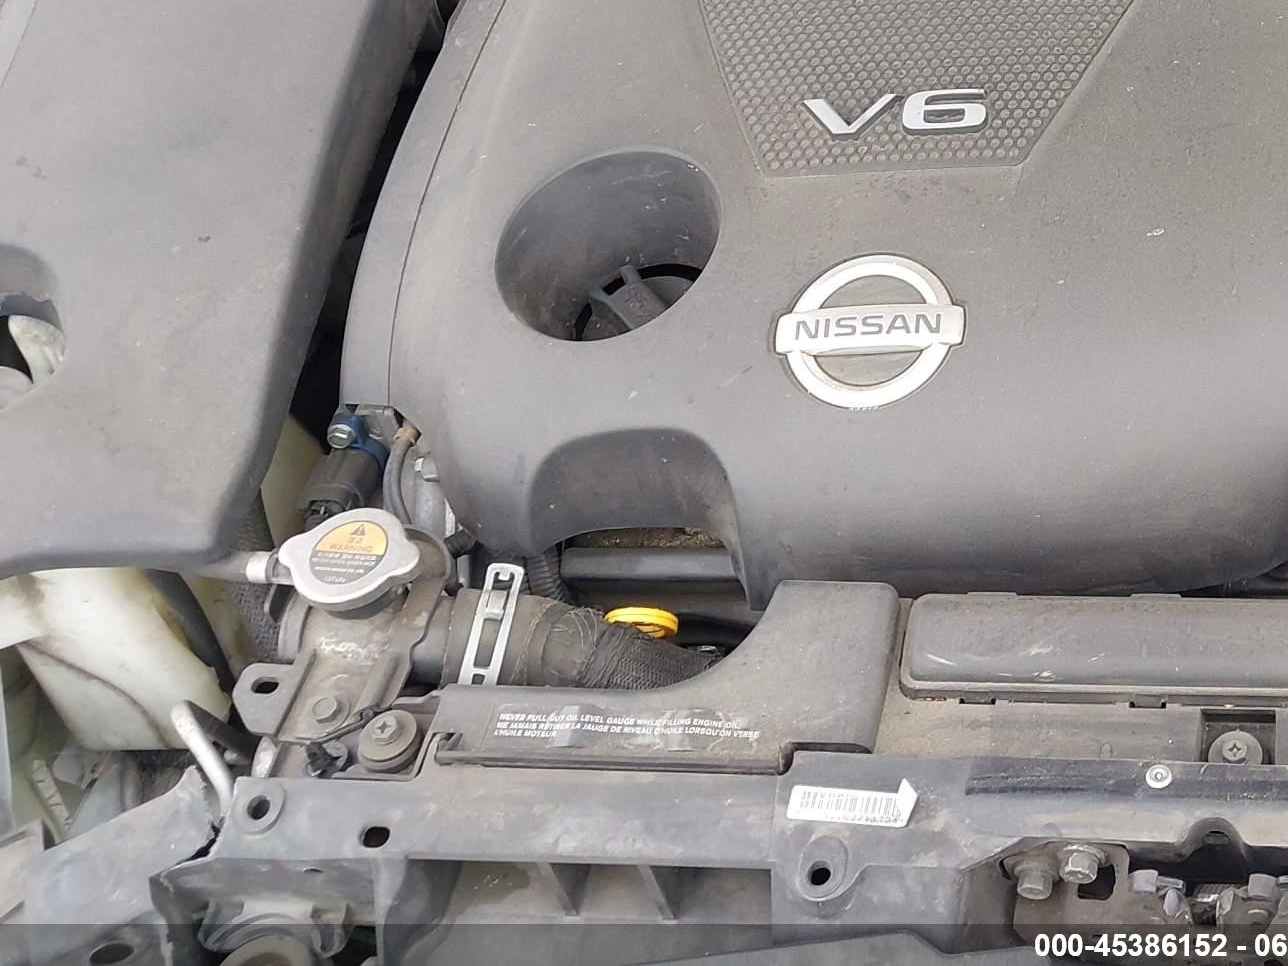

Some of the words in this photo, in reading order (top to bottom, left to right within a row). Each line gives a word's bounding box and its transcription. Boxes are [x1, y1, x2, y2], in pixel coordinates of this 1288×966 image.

[802, 89, 988, 136] V6
[795, 313, 942, 341] NISSAN
[329, 544, 374, 553] WARNING
[499, 713, 526, 722] NEVER
[526, 714, 546, 722] PULL
[549, 714, 565, 722] OUT
[566, 714, 579, 723] OIL
[580, 714, 604, 724] LEVEL
[606, 716, 635, 726] GAUGE
[636, 718, 661, 726] WHILE
[662, 718, 691, 726] FILLING
[692, 718, 725, 729] ENGINE
[494, 729, 522, 737] L'HUILE
[509, 722, 537, 730] JAMAIS
[571, 722, 581, 730] LA
[582, 724, 609, 732] JAUGE
[610, 725, 622, 733] DE
[623, 726, 652, 734] NIVEAU
[685, 727, 732, 737] LORSQU'ON
[733, 730, 760, 738] VERSE
